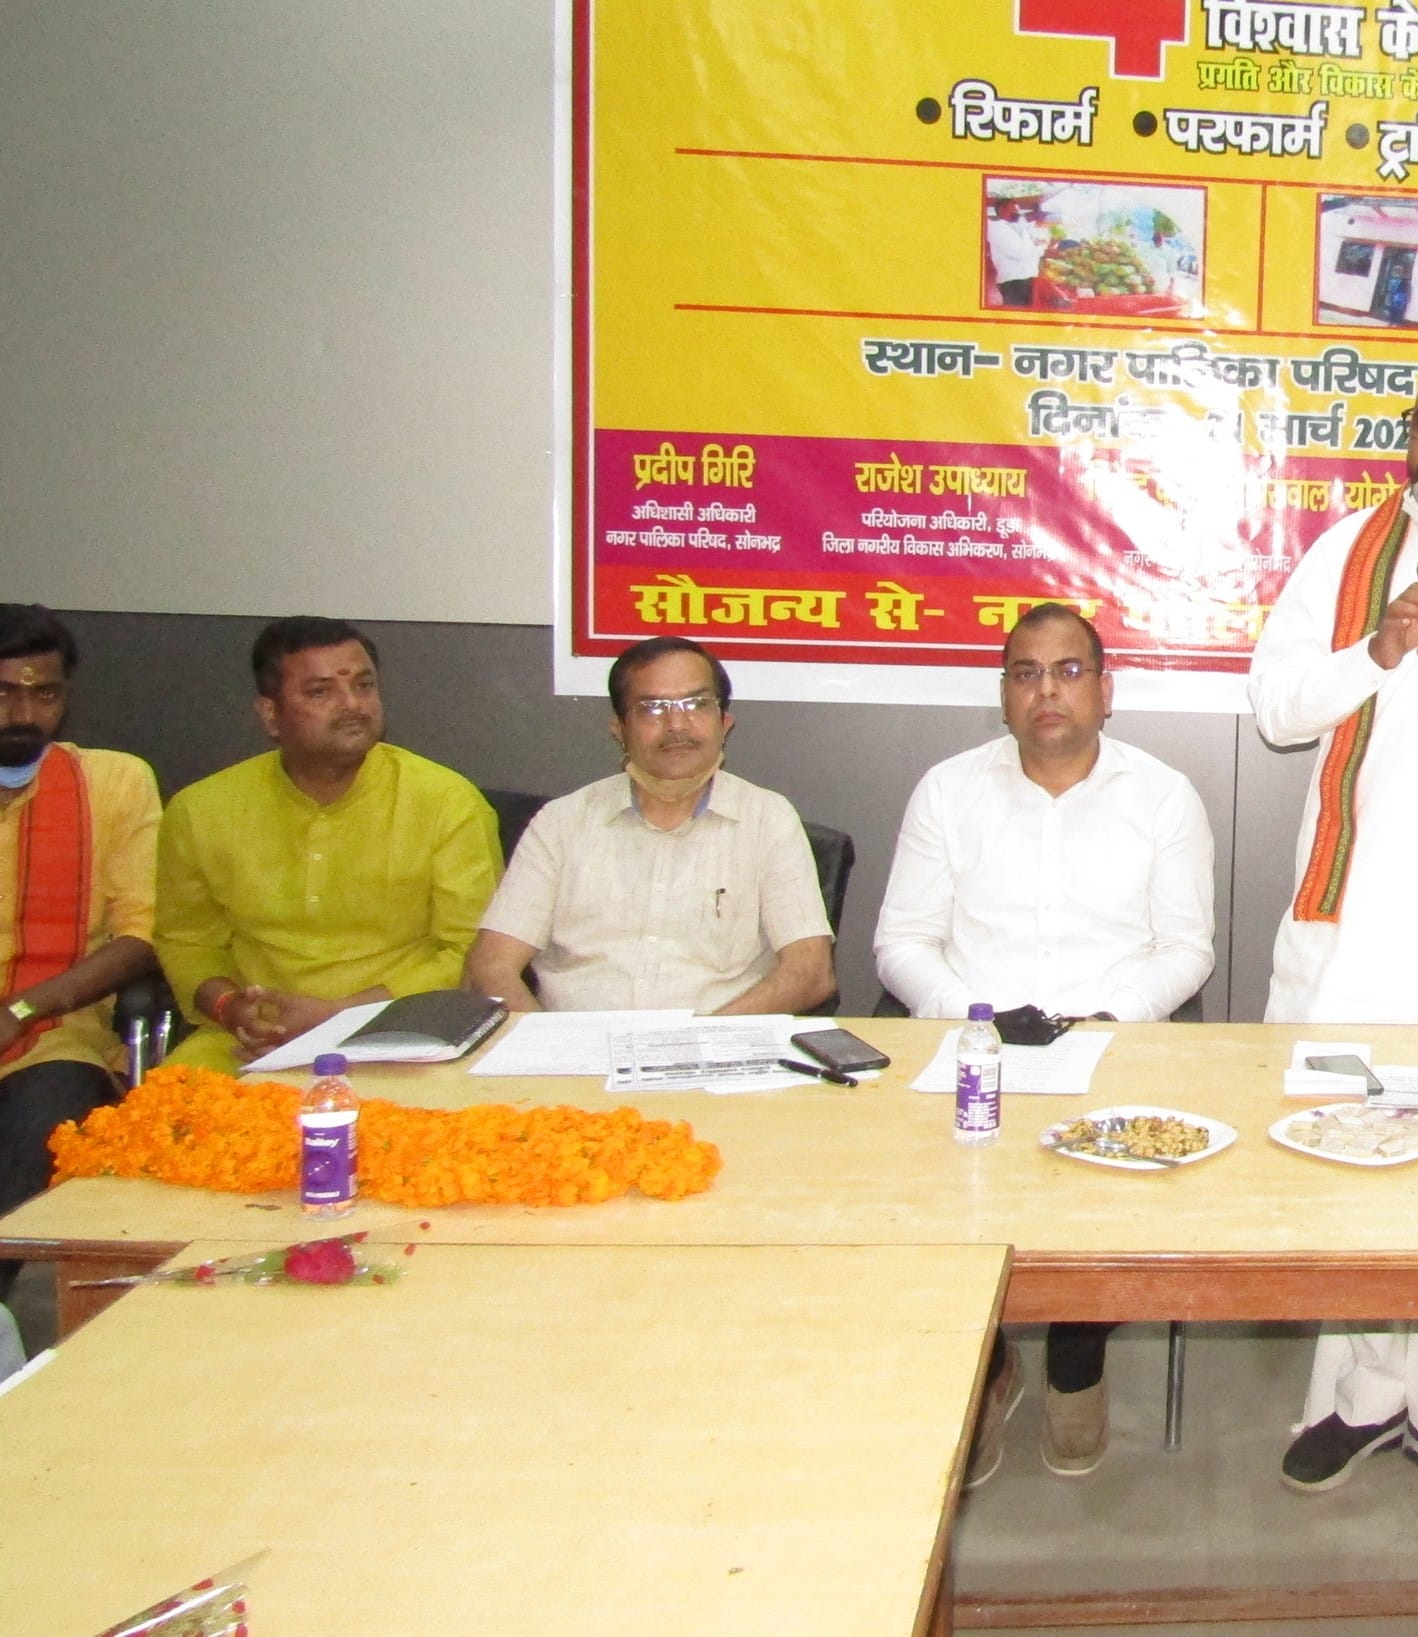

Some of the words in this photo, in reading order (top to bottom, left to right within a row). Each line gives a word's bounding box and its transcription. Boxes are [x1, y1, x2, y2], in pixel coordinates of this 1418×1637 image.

[1198, 56, 1261, 91] प्रगति
[1268, 59, 1314, 95] और
[1320, 62, 1394, 99] विकास
[948, 78, 1099, 146] रिफार्म
[1164, 100, 1329, 159] परफार्म
[1012, 345, 1119, 383] नगर
[1291, 347, 1418, 396] परिषद
[1353, 417, 1412, 450] 202
[633, 442, 696, 490] प्रदीप
[701, 443, 756, 488] गिरि
[854, 451, 923, 494] राजेश
[929, 464, 1028, 498] उपाध्याय
[631, 500, 694, 521] अधिशासी
[697, 502, 756, 523] अधिकारी
[861, 507, 927, 530] परियोजना
[929, 510, 991, 532] अधिकारी,
[605, 529, 638, 546] नगर
[639, 525, 685, 548] पालिका
[688, 527, 731, 550] परिषद,
[735, 529, 782, 553] सोनभद्र
[822, 531, 854, 554] जिला
[857, 533, 901, 555] नगरीय
[903, 533, 944, 557] विकास
[629, 574, 847, 628] सौजन्य
